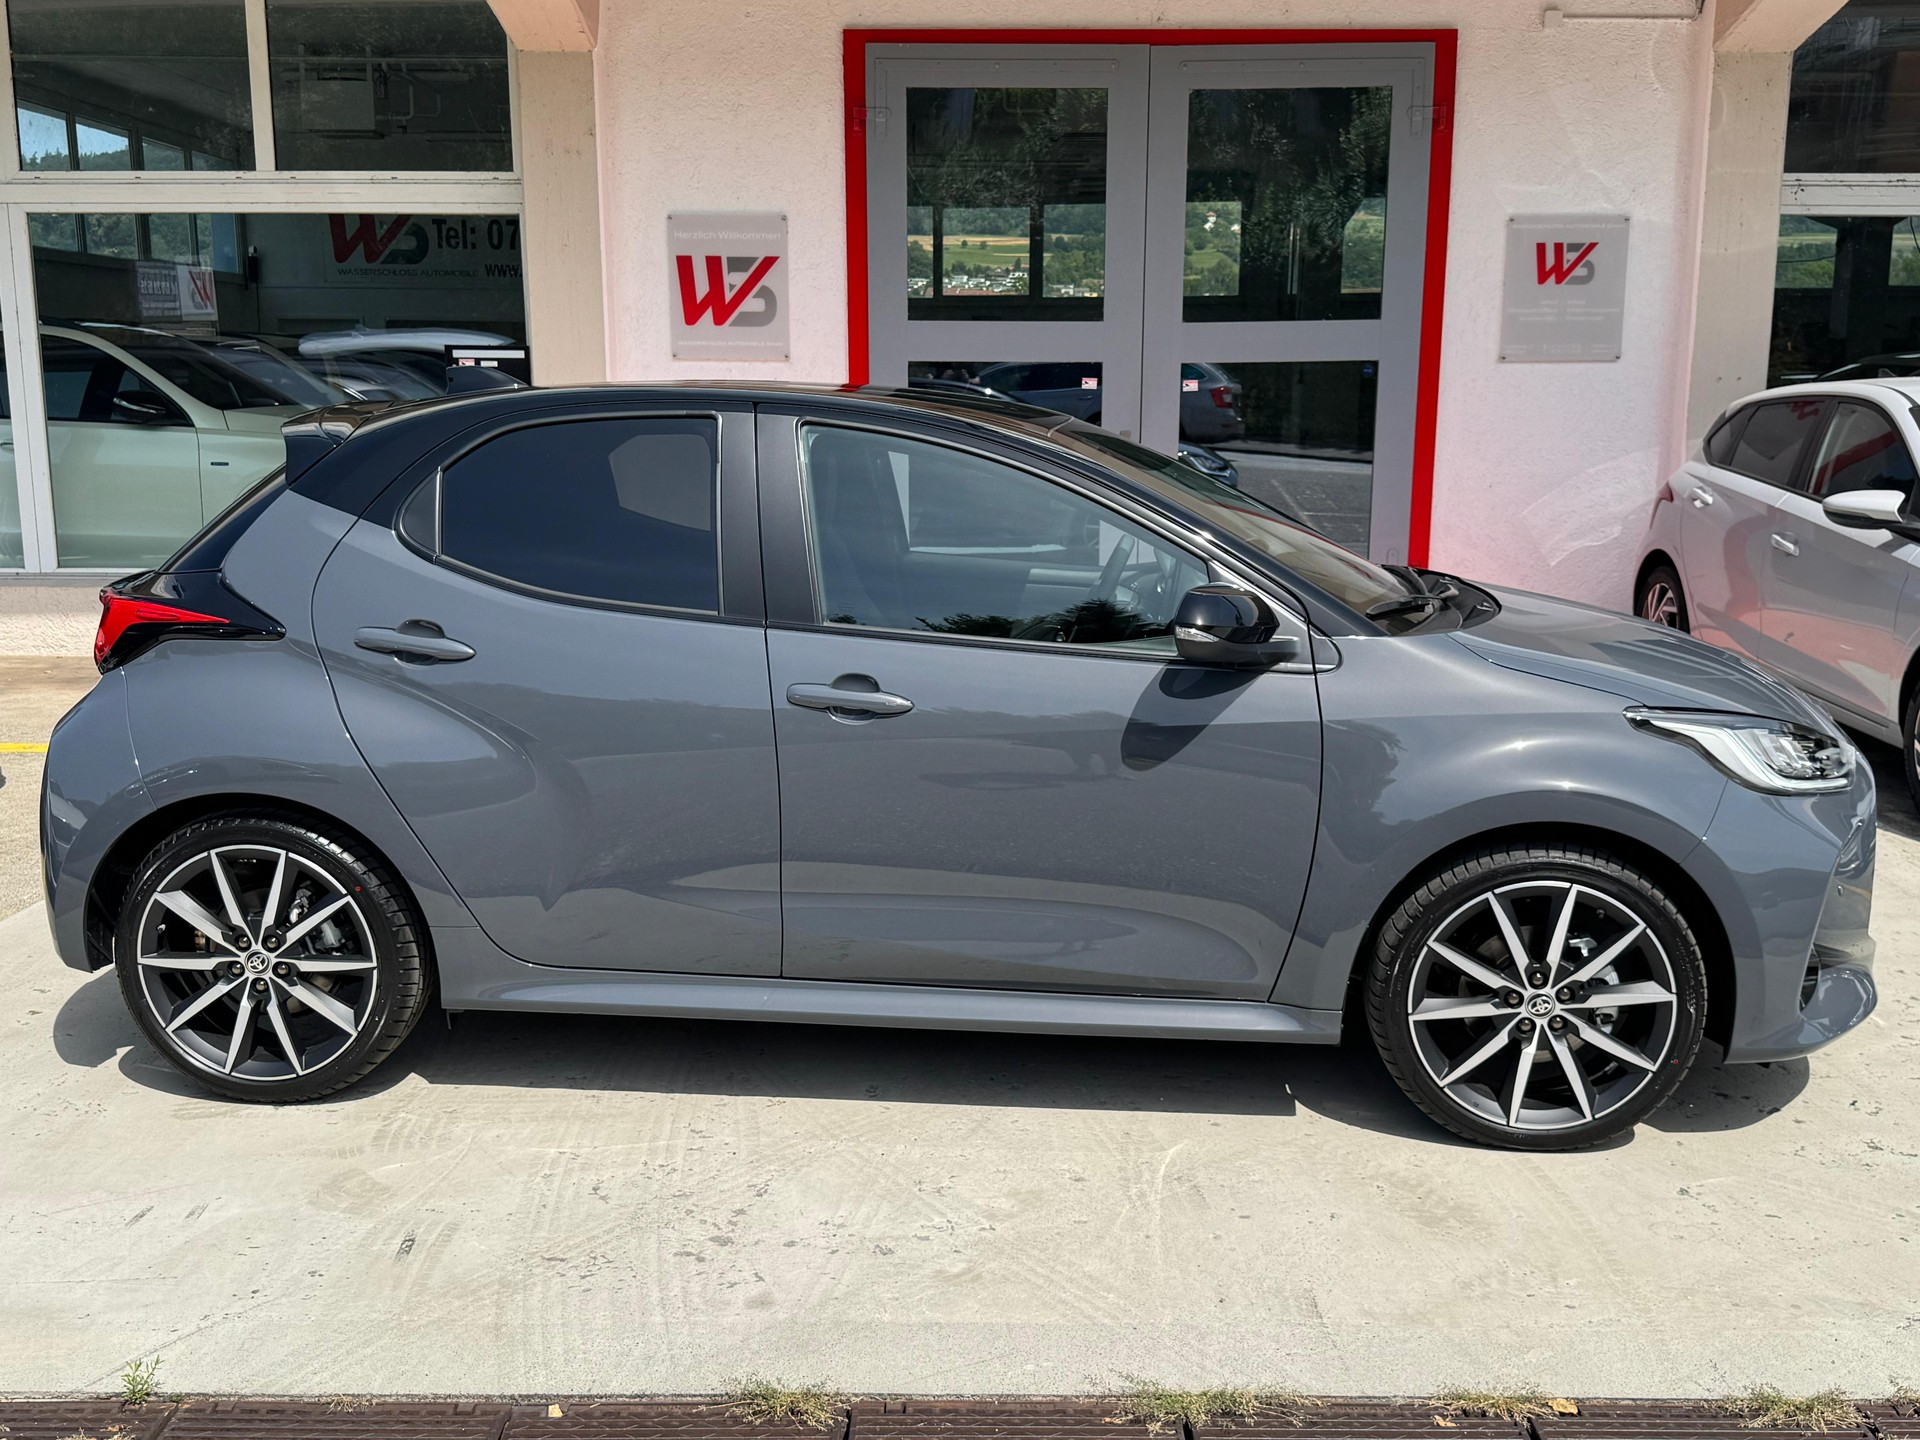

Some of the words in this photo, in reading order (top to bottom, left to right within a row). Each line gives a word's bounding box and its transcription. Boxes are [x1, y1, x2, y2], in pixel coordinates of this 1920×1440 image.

[432, 219, 476, 250] Tel:
[487, 219, 520, 250] 07
[674, 231, 716, 240] Herzlich
[718, 231, 781, 240] Willkommen
[338, 268, 418, 277] WASSERSCHLOSS
[420, 270, 478, 278] AUTOMOBILE
